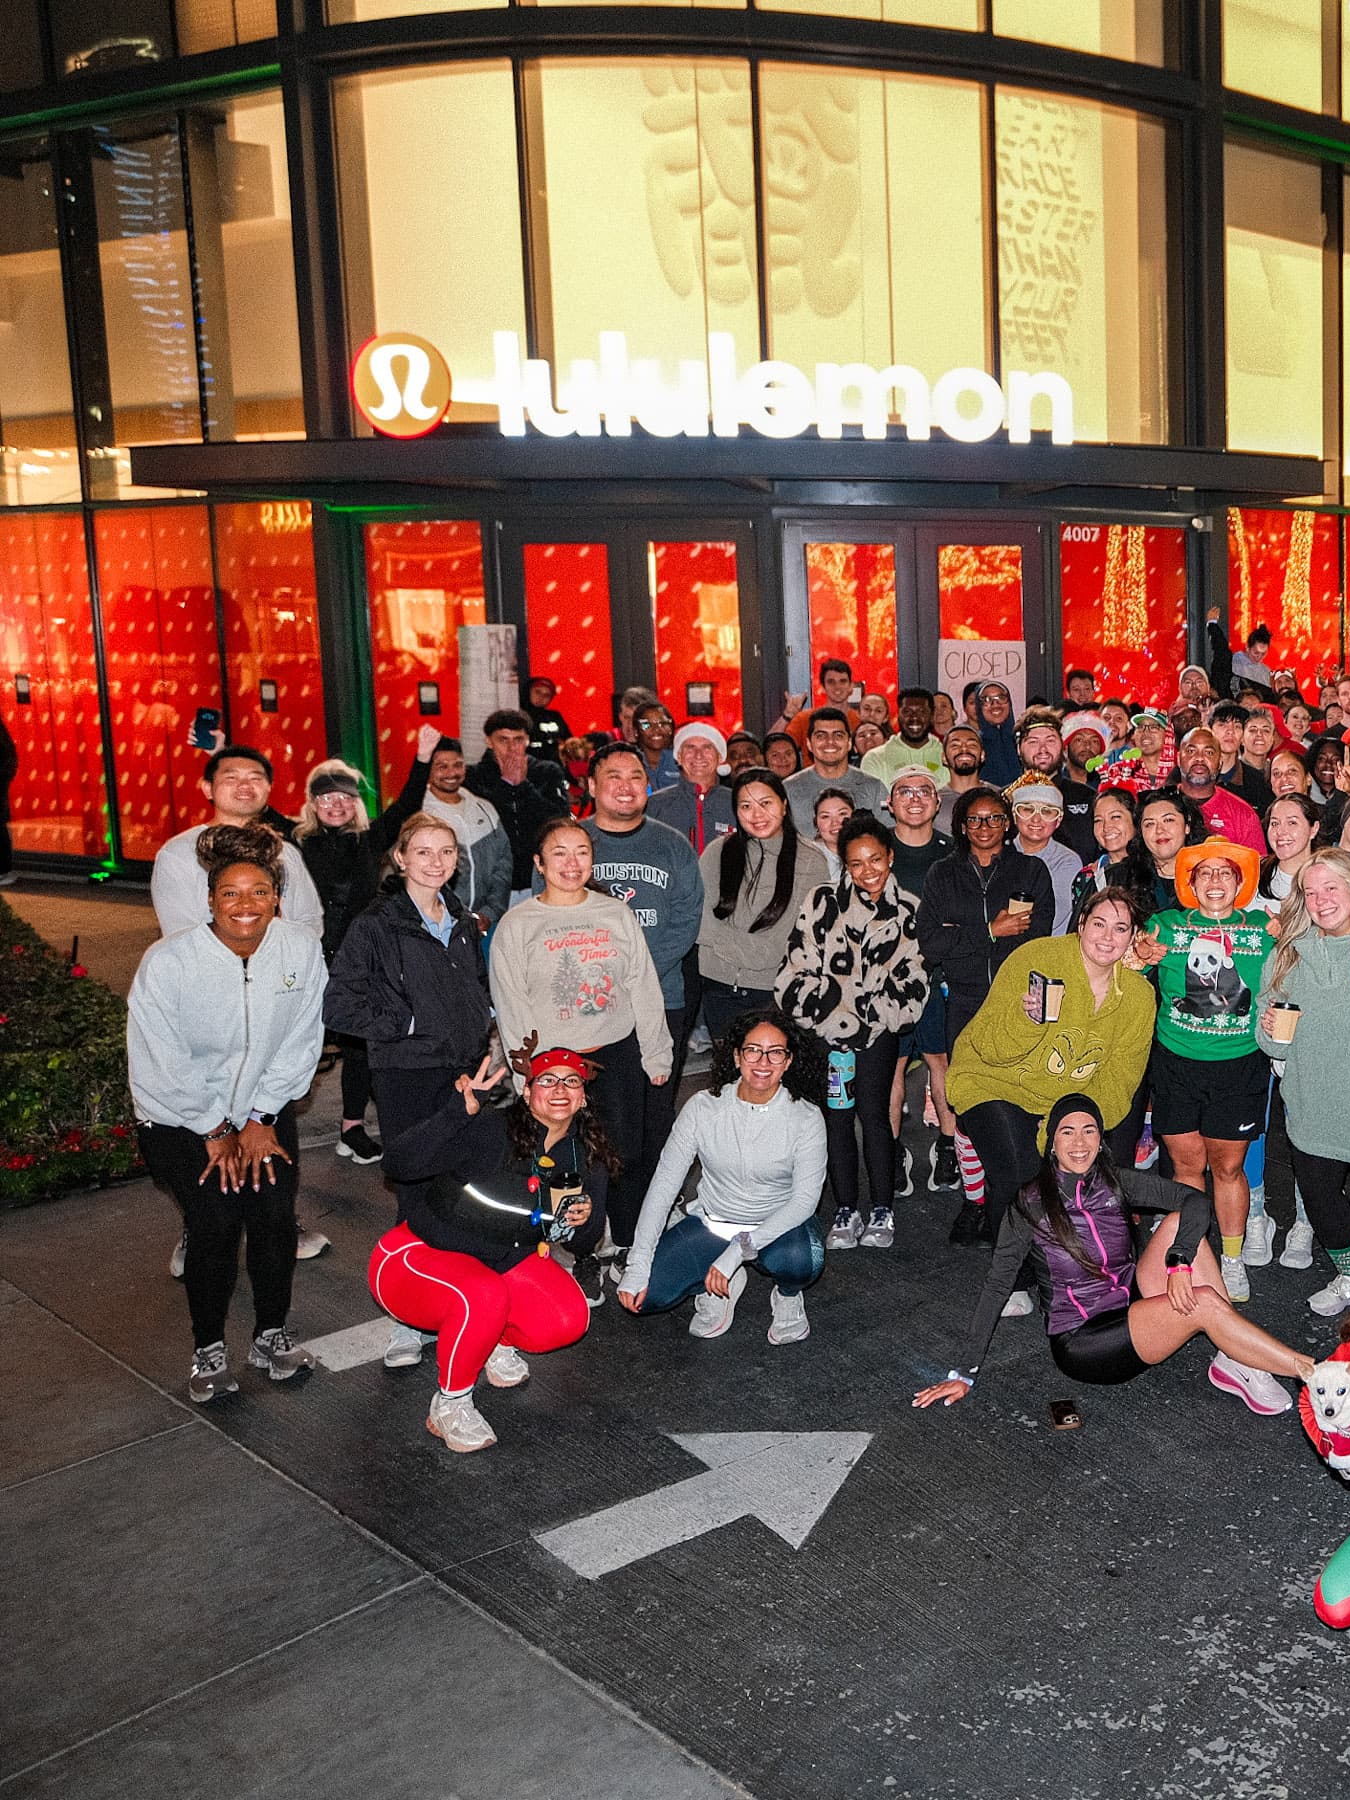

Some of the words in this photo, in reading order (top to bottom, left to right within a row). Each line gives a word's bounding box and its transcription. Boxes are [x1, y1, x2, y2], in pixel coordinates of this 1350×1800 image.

[493, 330, 1075, 446] lululemon
[1062, 526, 1101, 543] 4007
[591, 862, 669, 889] OUSTON
[544, 928, 611, 951] Wonderful
[578, 948, 618, 963] Time
